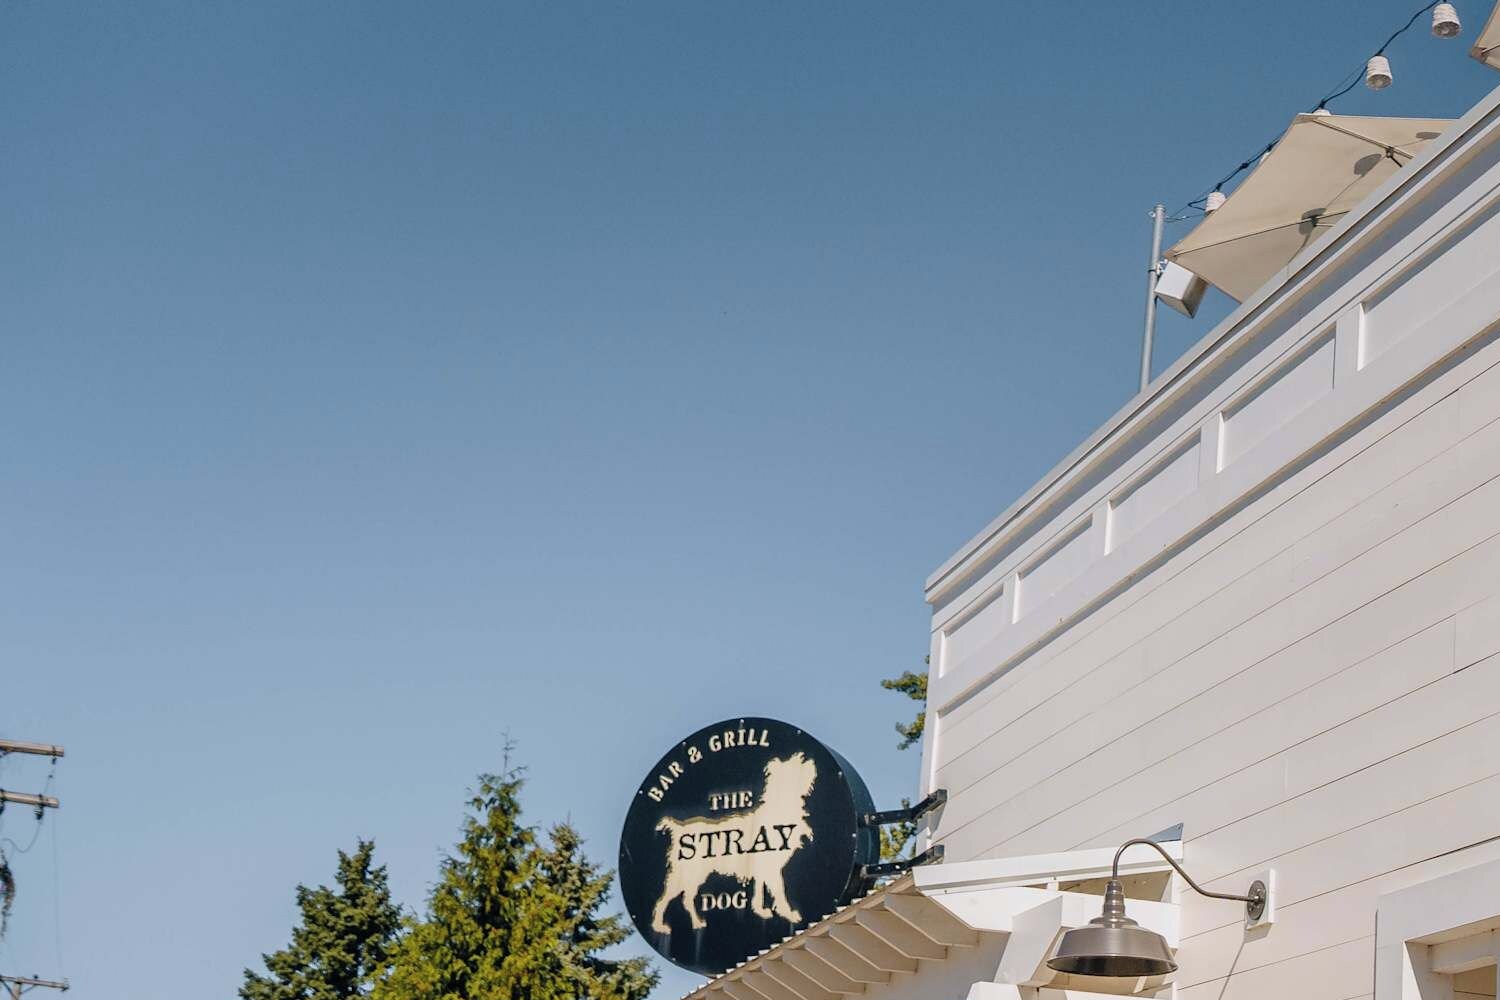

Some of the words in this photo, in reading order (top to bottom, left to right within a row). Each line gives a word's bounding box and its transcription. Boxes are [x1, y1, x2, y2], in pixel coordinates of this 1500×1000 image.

[647, 761, 684, 803] BAR
[688, 746, 704, 764] &
[708, 728, 770, 752] GRILL
[708, 791, 753, 811] THE
[678, 824, 796, 861] STRAY
[700, 891, 748, 912] DOG
